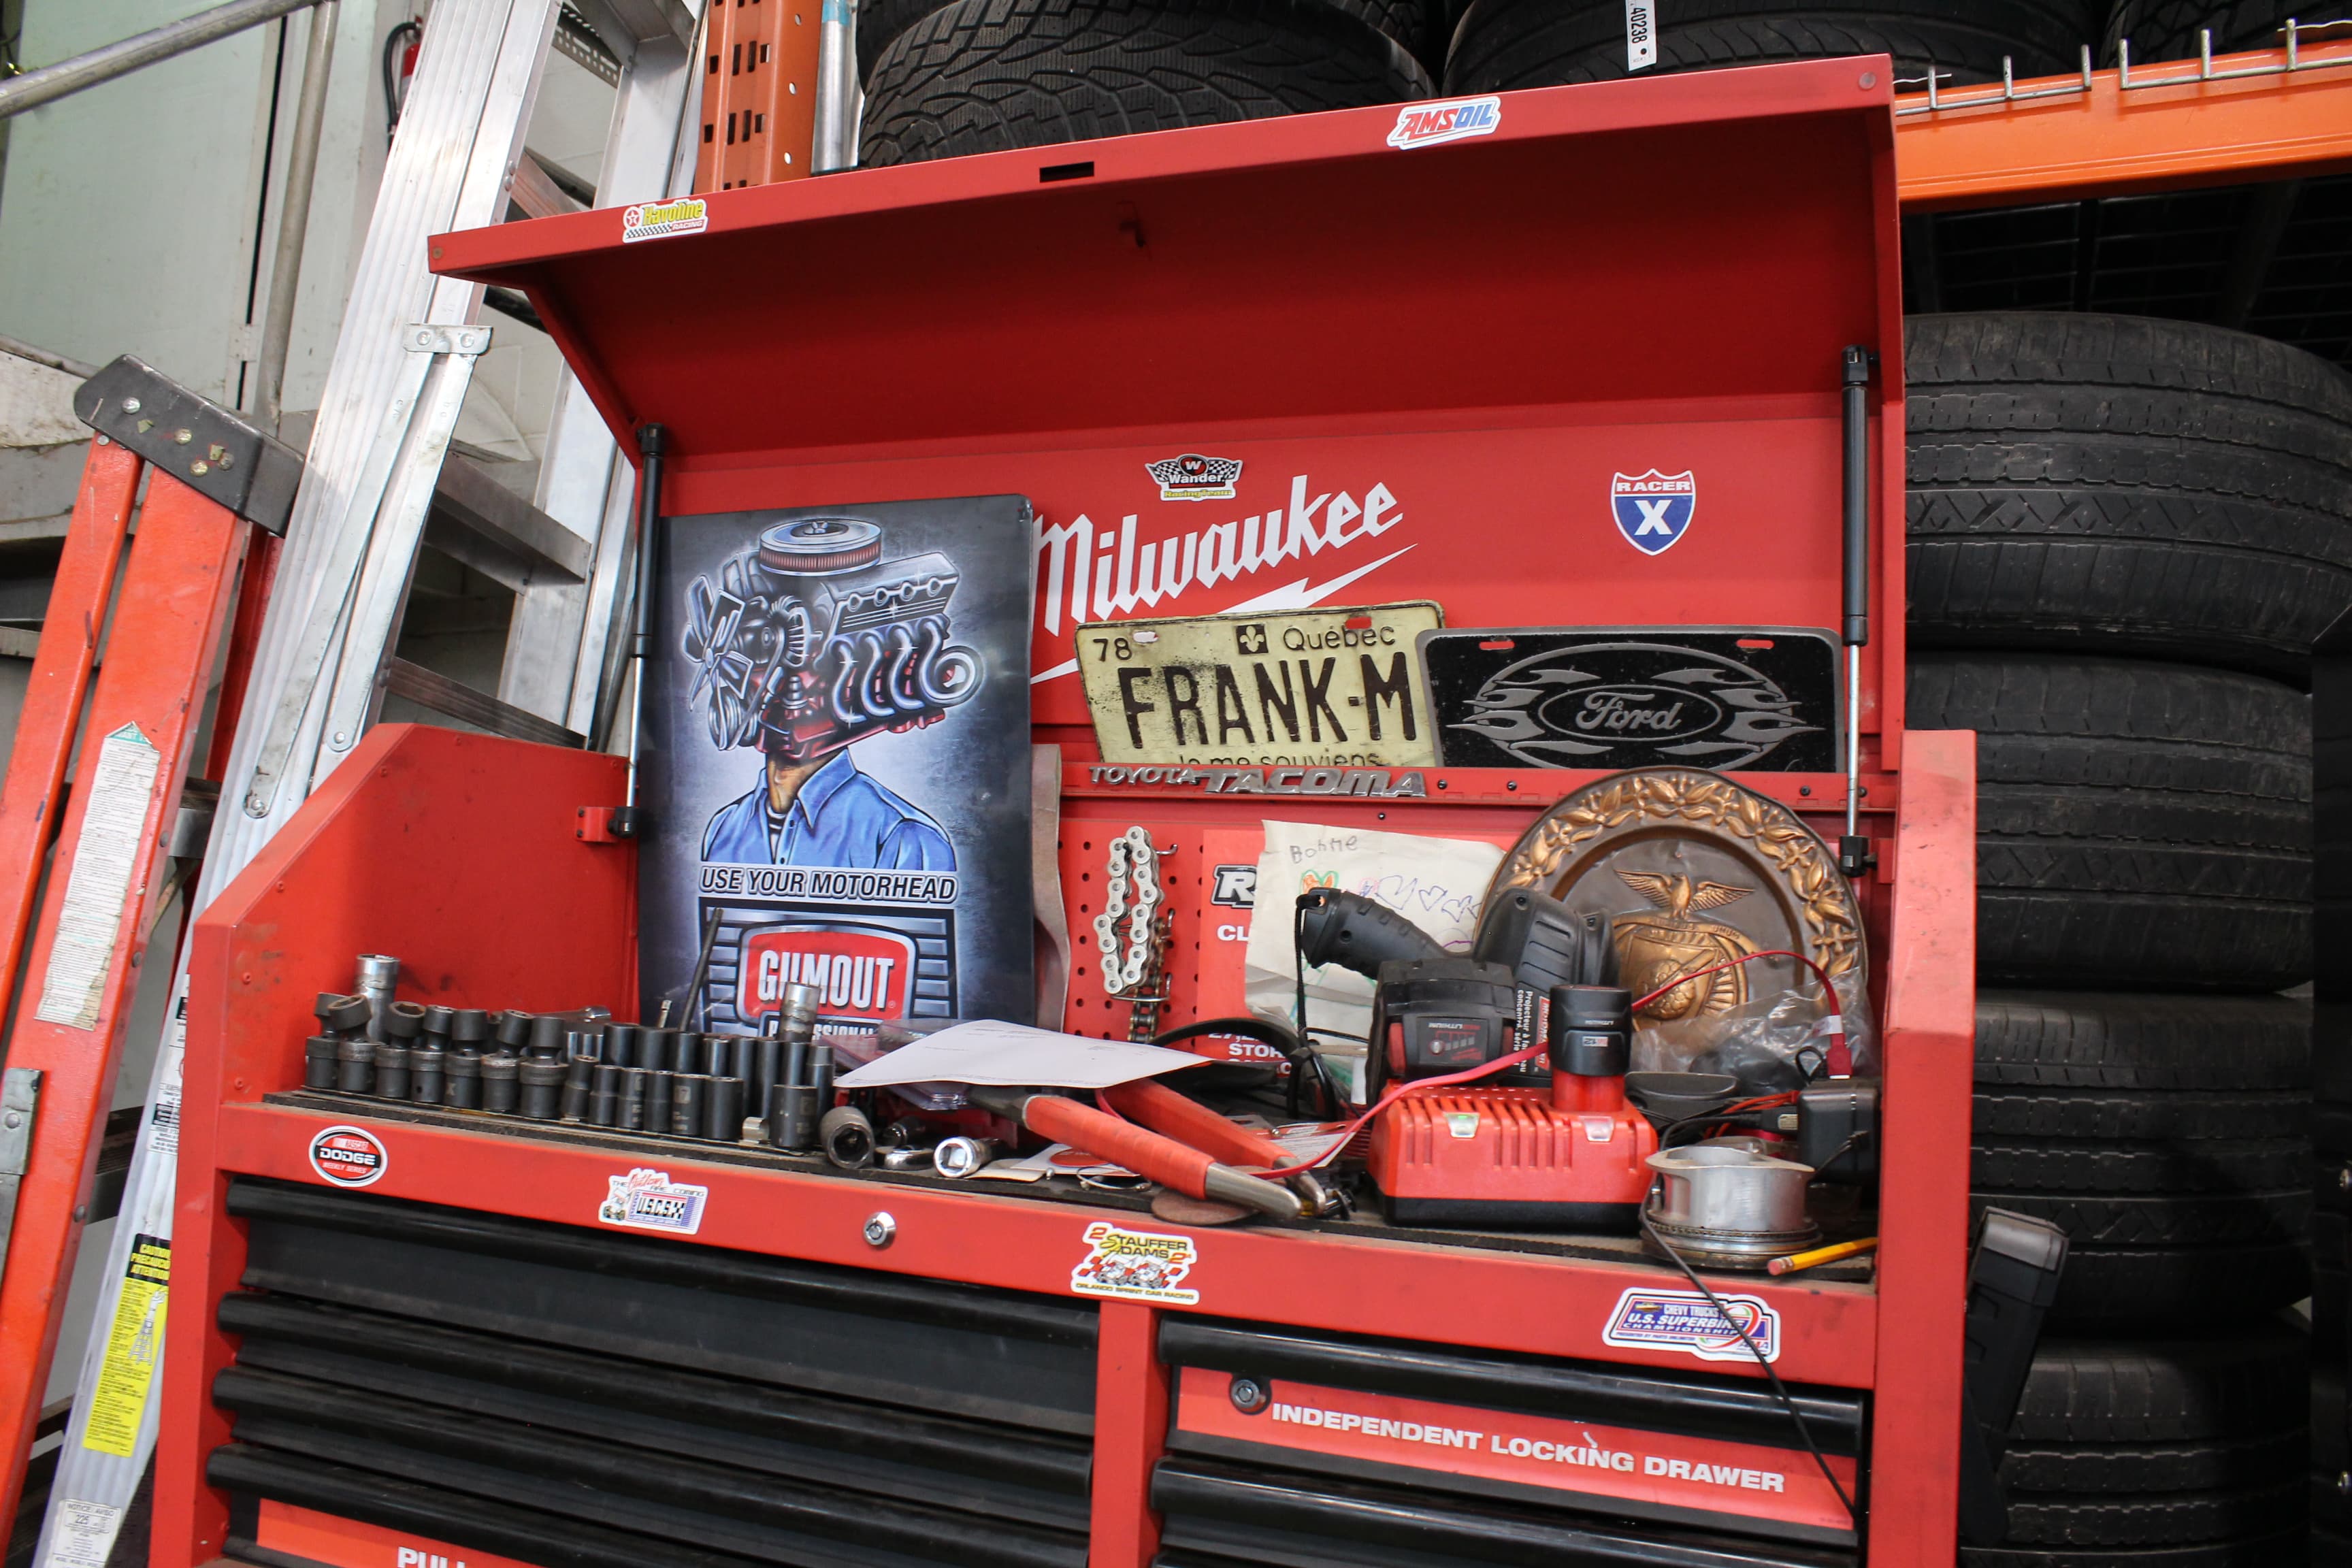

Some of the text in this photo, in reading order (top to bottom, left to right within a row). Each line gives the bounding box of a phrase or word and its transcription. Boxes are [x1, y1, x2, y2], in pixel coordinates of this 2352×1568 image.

[1631, 7, 1648, 44] 40238
[1397, 104, 1493, 140] AMSOIL
[642, 201, 704, 226] Havoline
[672, 220, 703, 231] RACING
[1616, 481, 1690, 491] RACER
[1634, 500, 1673, 536] X
[1032, 474, 1404, 637] Milwaukee
[1093, 637, 1132, 661] 78
[1118, 651, 1417, 749] FRANK-M
[1575, 691, 1684, 730] Ford
[1090, 767, 1427, 797] TOYOTA TACOMA
[702, 868, 956, 900] USE YOUR MOTORHEAD
[757, 949, 895, 1009] GUMOUT
[319, 1147, 376, 1165] DODGE
[1090, 1226, 1108, 1239] 2
[1627, 1313, 1655, 1324] U.S.
[1664, 1303, 1689, 1316] CHEVY
[1622, 1322, 1740, 1336] CHAMPIONSHIP
[1272, 1402, 1784, 1492] INDEPENDENT LOCKING DRAWER
